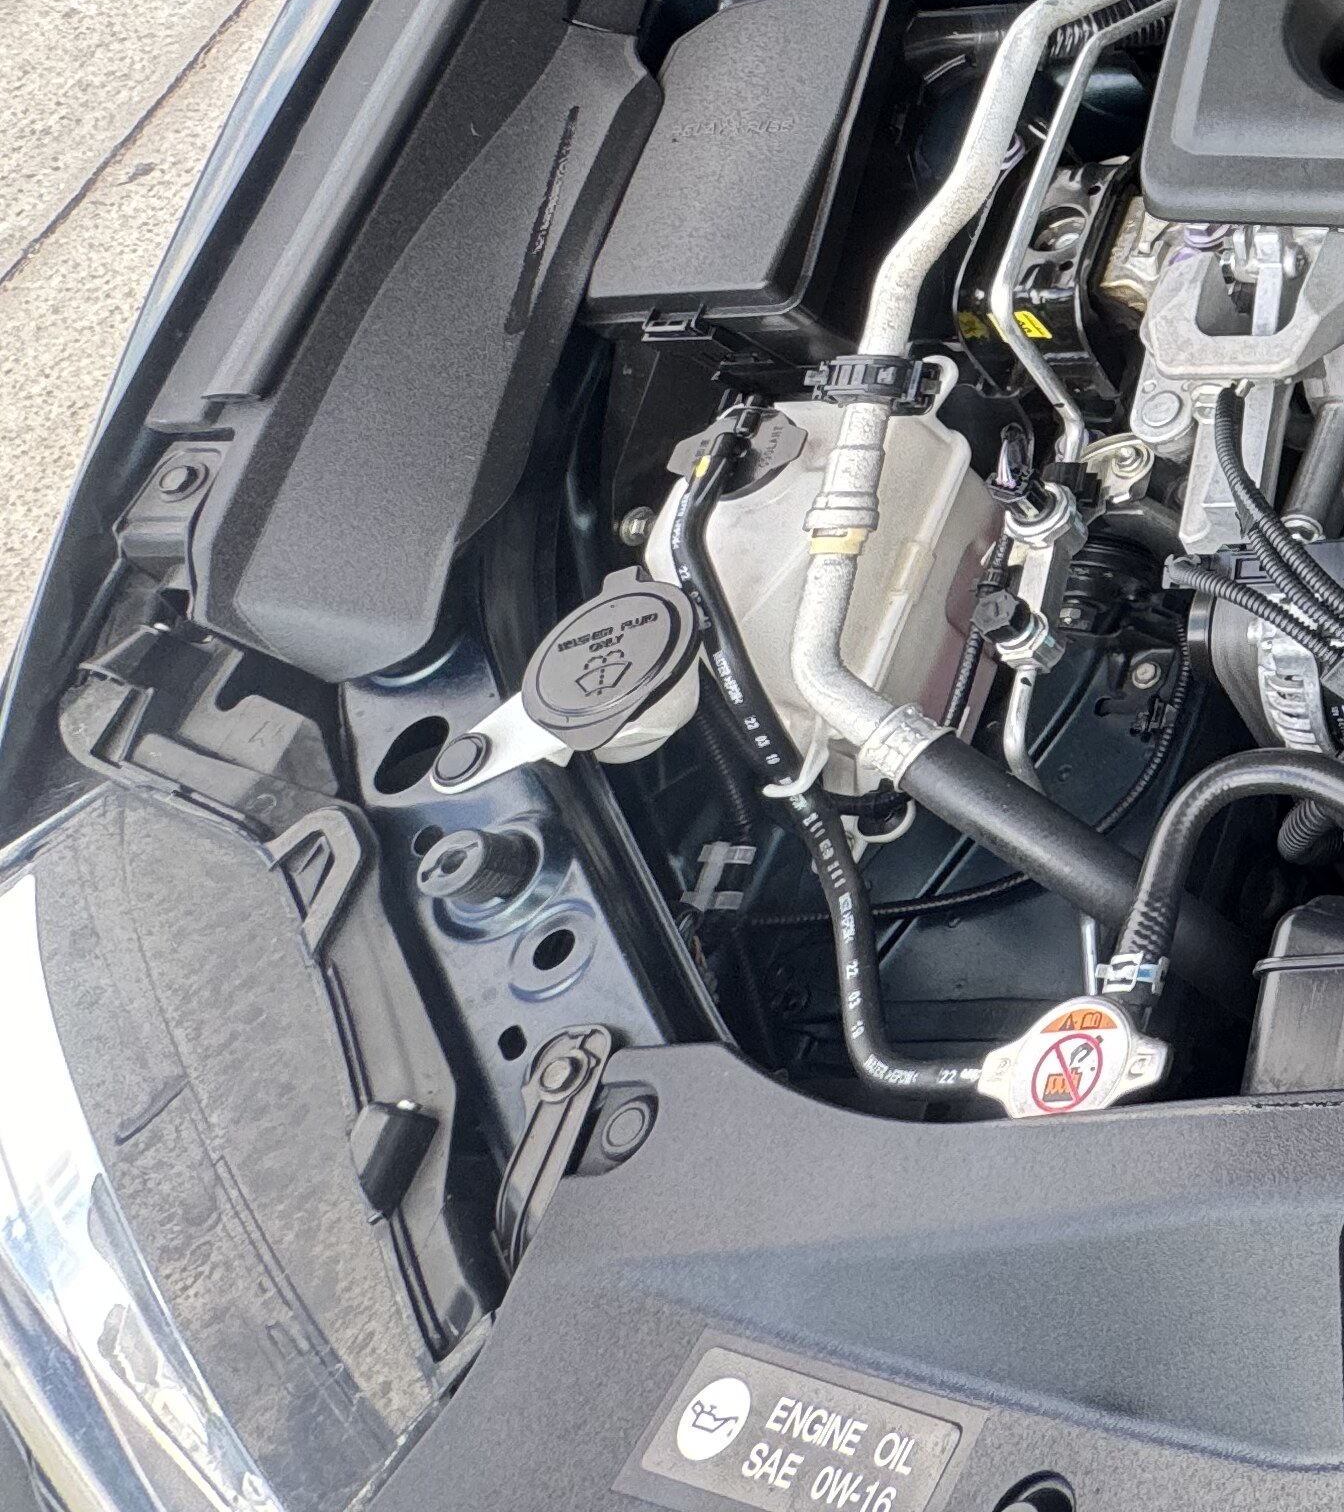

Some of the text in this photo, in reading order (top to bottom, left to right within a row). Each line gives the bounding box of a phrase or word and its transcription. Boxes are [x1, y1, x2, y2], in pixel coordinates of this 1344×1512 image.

[588, 633, 625, 653] ONLY
[765, 1396, 916, 1476] ENGINE OIL
[741, 1442, 898, 1512] SAE 0W-16
